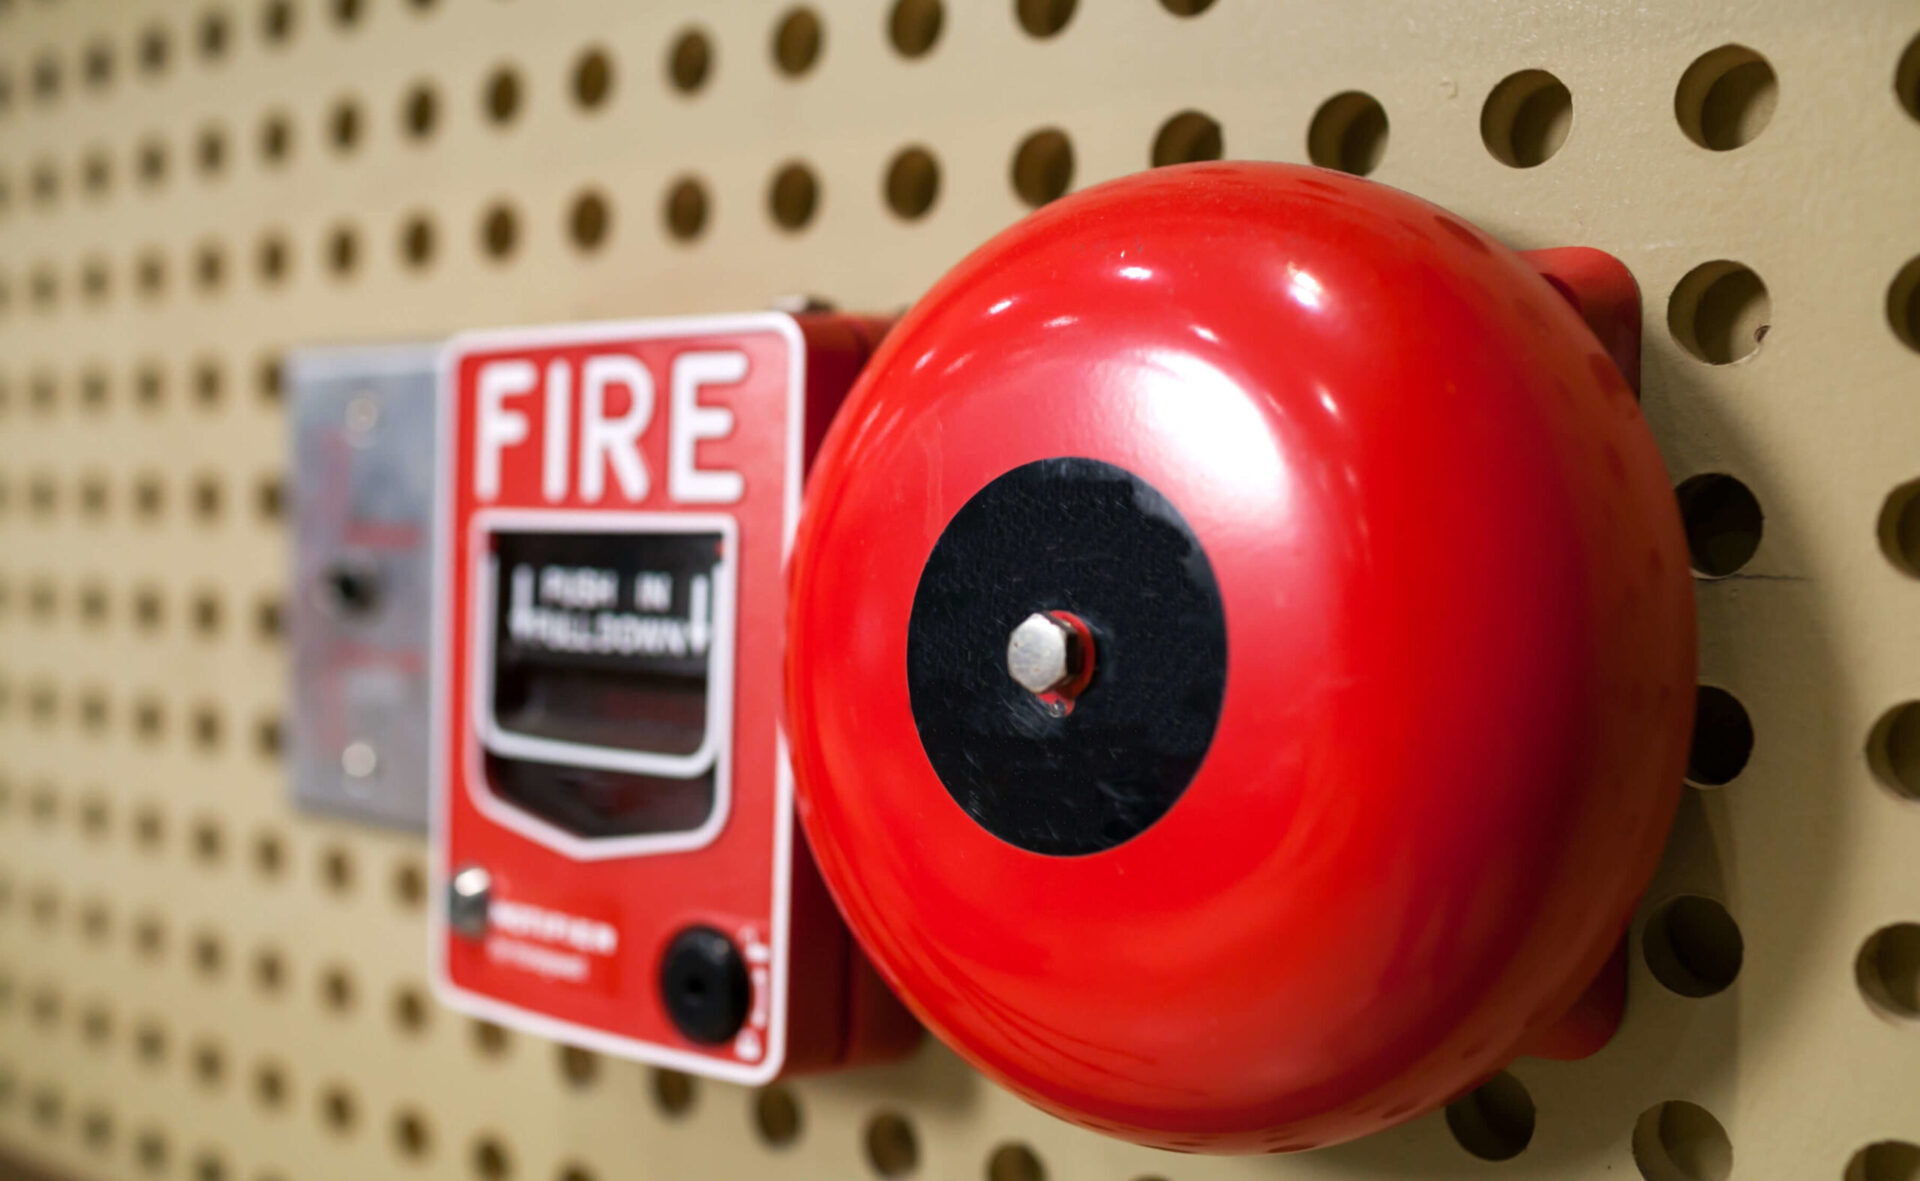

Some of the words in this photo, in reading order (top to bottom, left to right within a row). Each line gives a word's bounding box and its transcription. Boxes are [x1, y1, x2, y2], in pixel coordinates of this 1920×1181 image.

[475, 351, 748, 503] FIRE
[540, 565, 619, 608] PUSH
[635, 571, 672, 612] IN
